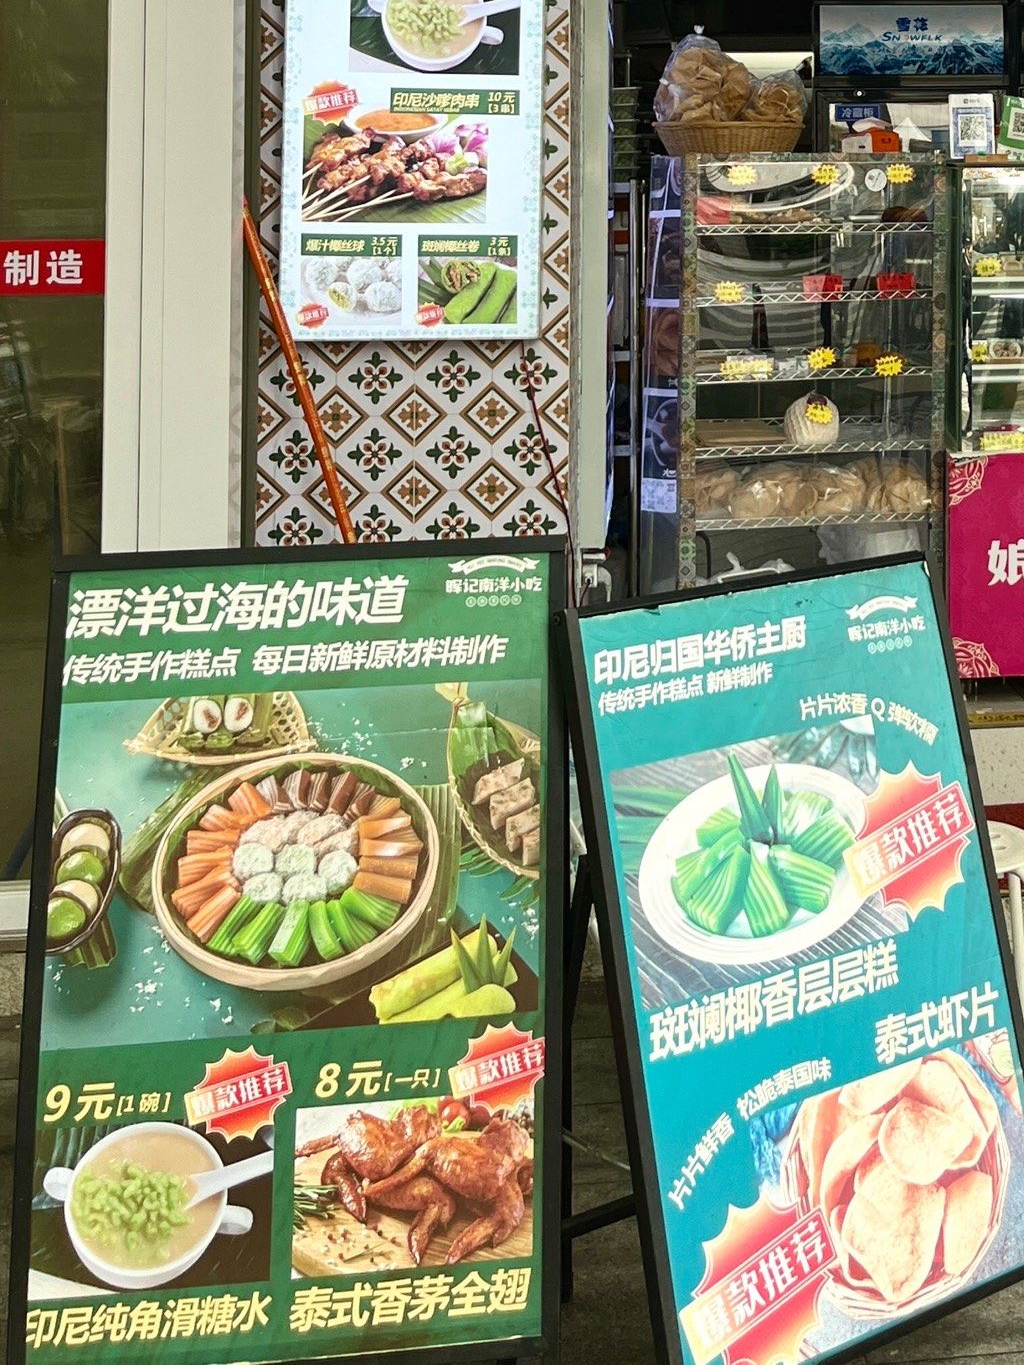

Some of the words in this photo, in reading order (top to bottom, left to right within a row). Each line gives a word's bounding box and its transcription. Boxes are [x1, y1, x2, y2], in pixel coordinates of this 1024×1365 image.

[3, 249, 83, 286] 制造
[64, 575, 409, 639] 漂洋过海的味道
[445, 576, 542, 594] 晖记南洋小吃
[62, 648, 241, 686] 传统手作糕点
[251, 636, 509, 677] 每日新鲜原材料制作
[594, 615, 807, 685] 印尼归国华侨主厨
[598, 675, 704, 717] 传统手作糕点
[706, 662, 773, 694] 新鲜制作
[800, 692, 867, 721] 片片浓香
[854, 792, 966, 889] 爆款推荐
[648, 939, 899, 1062] 斑斓椰香层层糕
[875, 981, 999, 1064] 泰式虾片
[189, 1066, 289, 1120] 爆款推荐
[314, 1060, 384, 1099] 8元
[453, 1043, 544, 1096] 爆款推荐
[43, 1082, 116, 1123] 9元
[668, 1112, 735, 1210] 片片鲜香
[736, 1057, 832, 1121] 松脆泰国味
[289, 1268, 532, 1332] 泰式香茅全翅
[702, 1220, 828, 1346] 爆款推荐
[25, 1291, 272, 1349] 印尼纯角滑糖水
